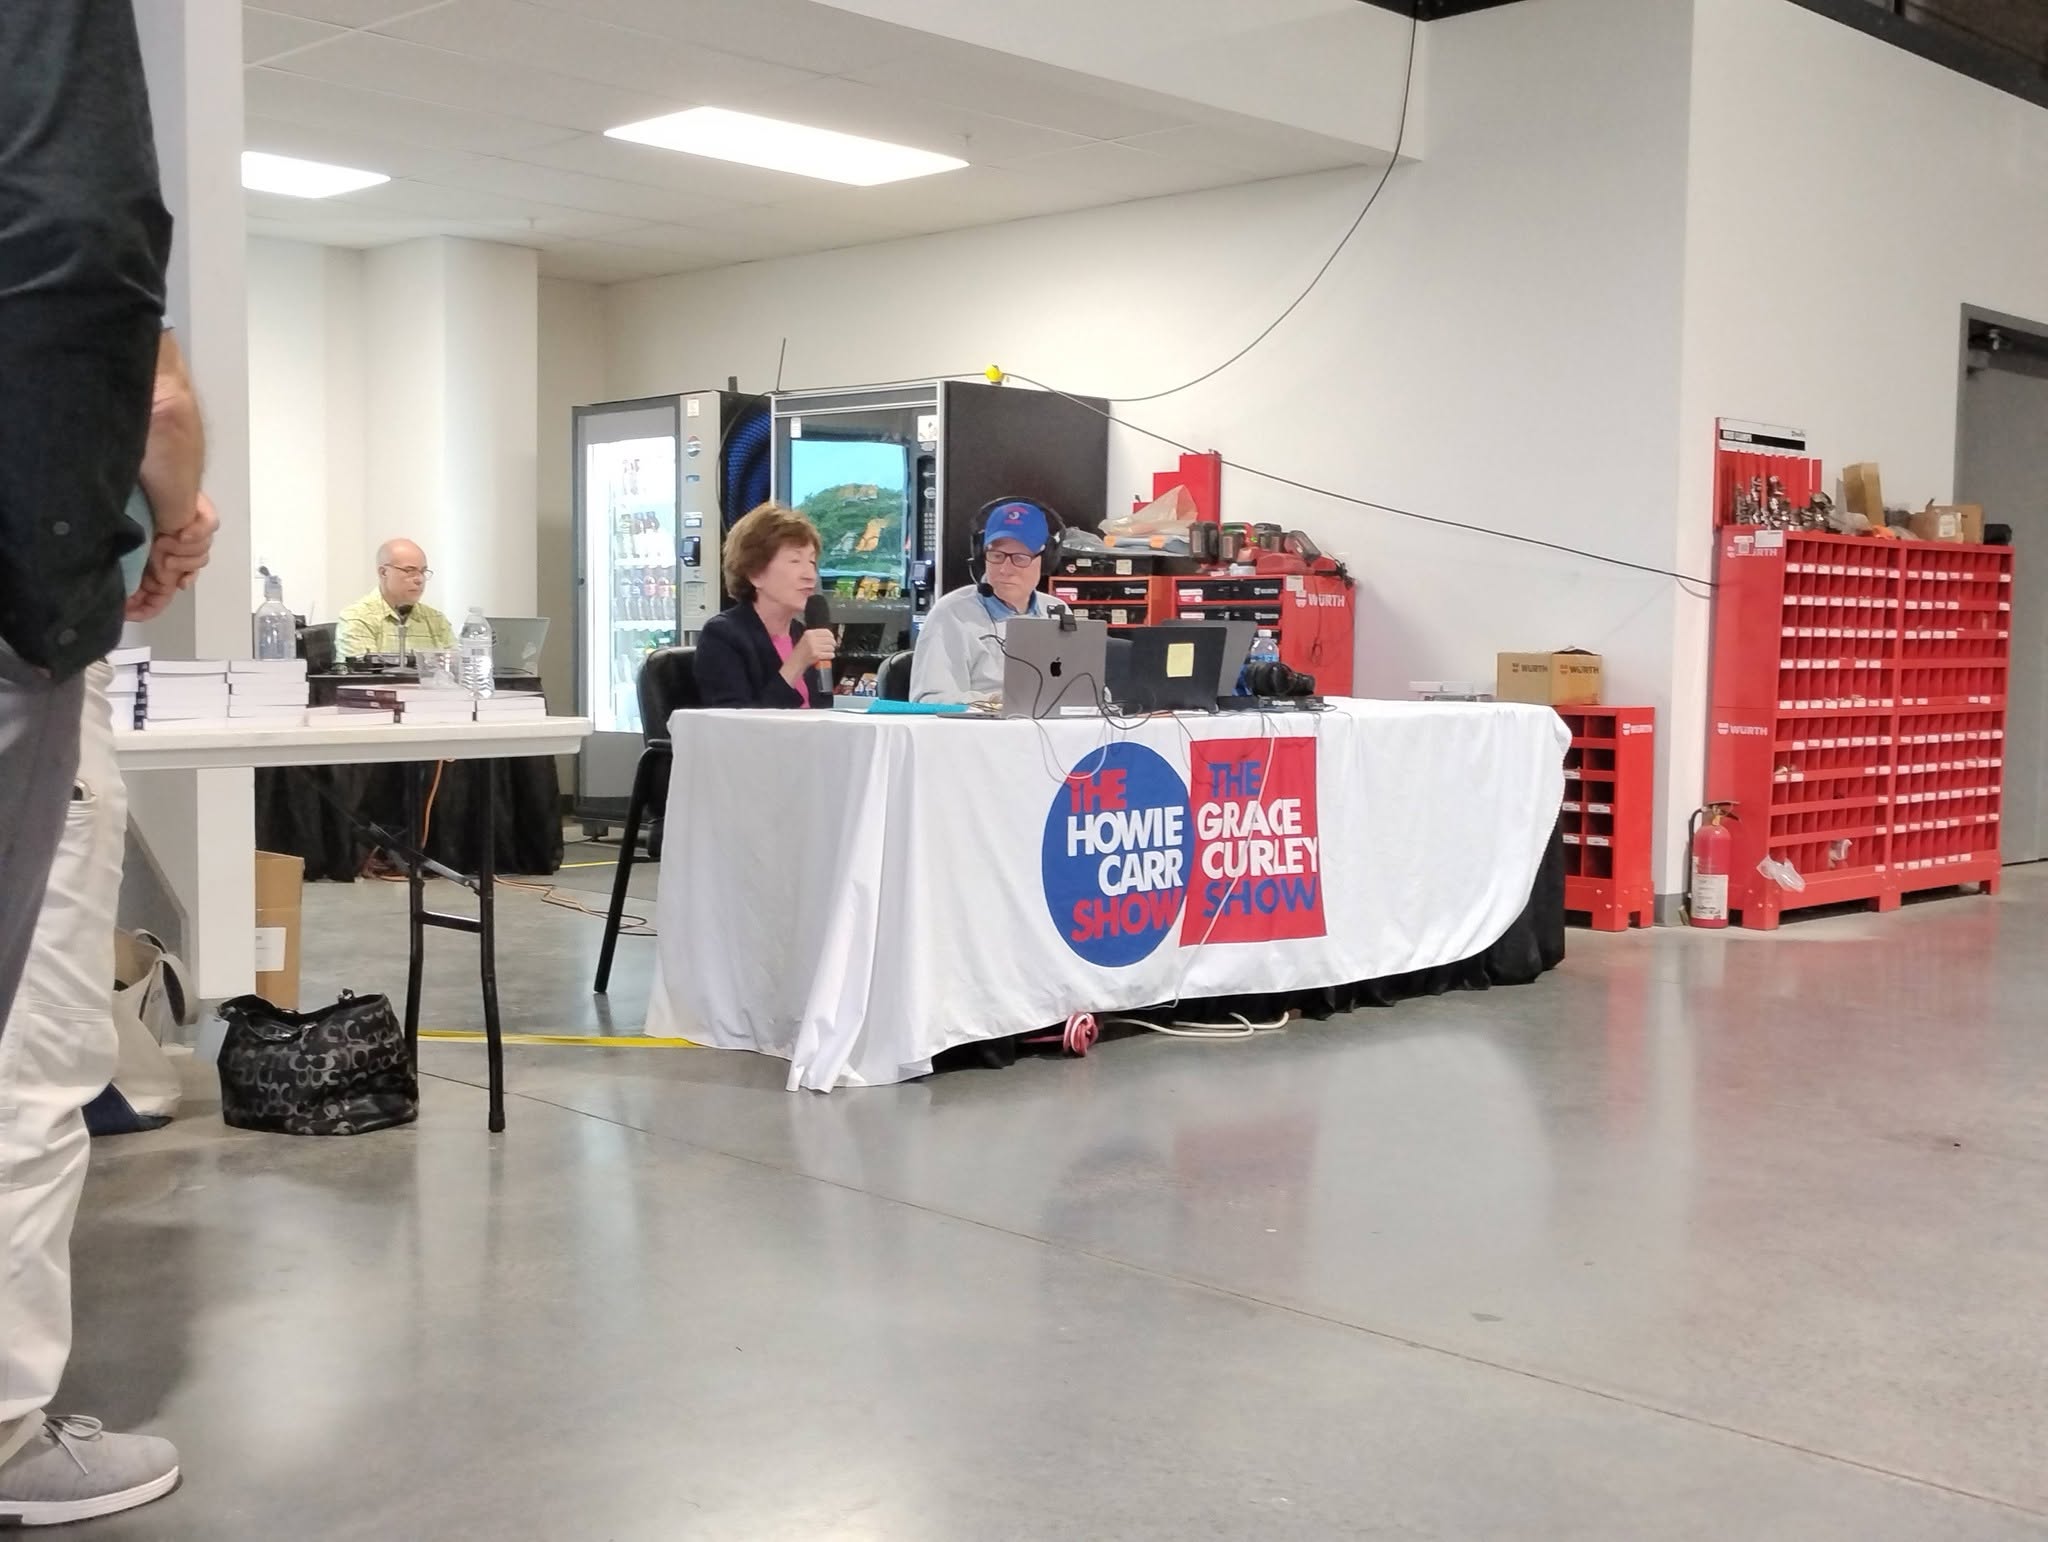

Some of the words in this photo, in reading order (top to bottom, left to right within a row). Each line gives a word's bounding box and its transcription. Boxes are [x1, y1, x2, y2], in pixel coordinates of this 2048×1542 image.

[1067, 769, 1127, 813] THE
[1208, 761, 1262, 798] THE
[1067, 806, 1184, 857] HOWIE
[1197, 798, 1302, 841] GRACE
[1098, 849, 1184, 897] CARR
[1202, 837, 1318, 880] CURLEY
[1071, 888, 1184, 942] SHOW
[1203, 876, 1318, 918] SHOW
